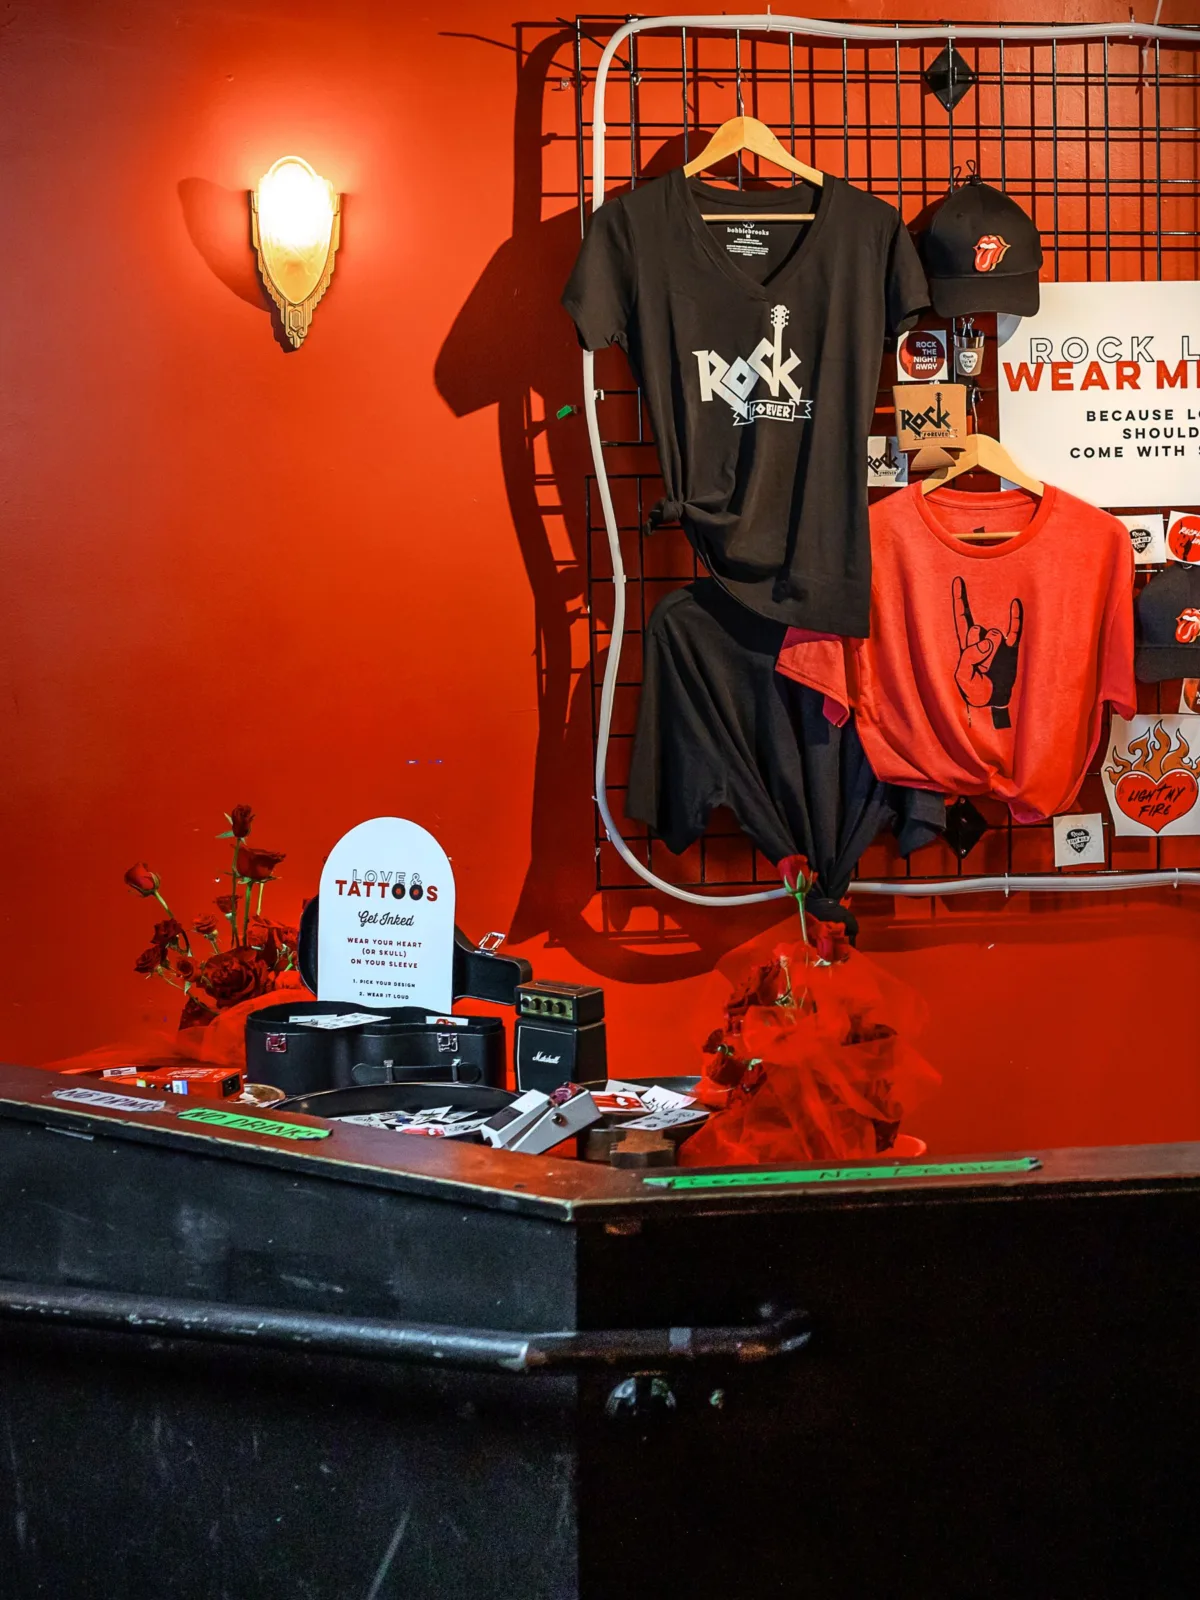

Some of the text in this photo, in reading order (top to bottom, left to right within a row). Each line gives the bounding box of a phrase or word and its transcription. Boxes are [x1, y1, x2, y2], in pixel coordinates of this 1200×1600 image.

[1030, 335, 1154, 364] ROCK
[692, 305, 802, 420] ROCK
[1003, 361, 1141, 391] WEAR
[899, 392, 951, 437] ROCK
[1086, 408, 1175, 422] BECAUSE
[1122, 426, 1200, 439] SHOULD
[1070, 445, 1124, 459] COME
[1136, 445, 1185, 457] WITH
[1128, 784, 1186, 803] LIGHT MY
[1138, 803, 1171, 818] FIRE
[352, 869, 406, 886] LOVE
[335, 880, 439, 901] TATTOOS
[358, 910, 414, 927] Get Inked
[379, 950, 407, 958] SKULL)
[389, 961, 418, 969] SLEEVE
[183, 1108, 226, 1124] NO
